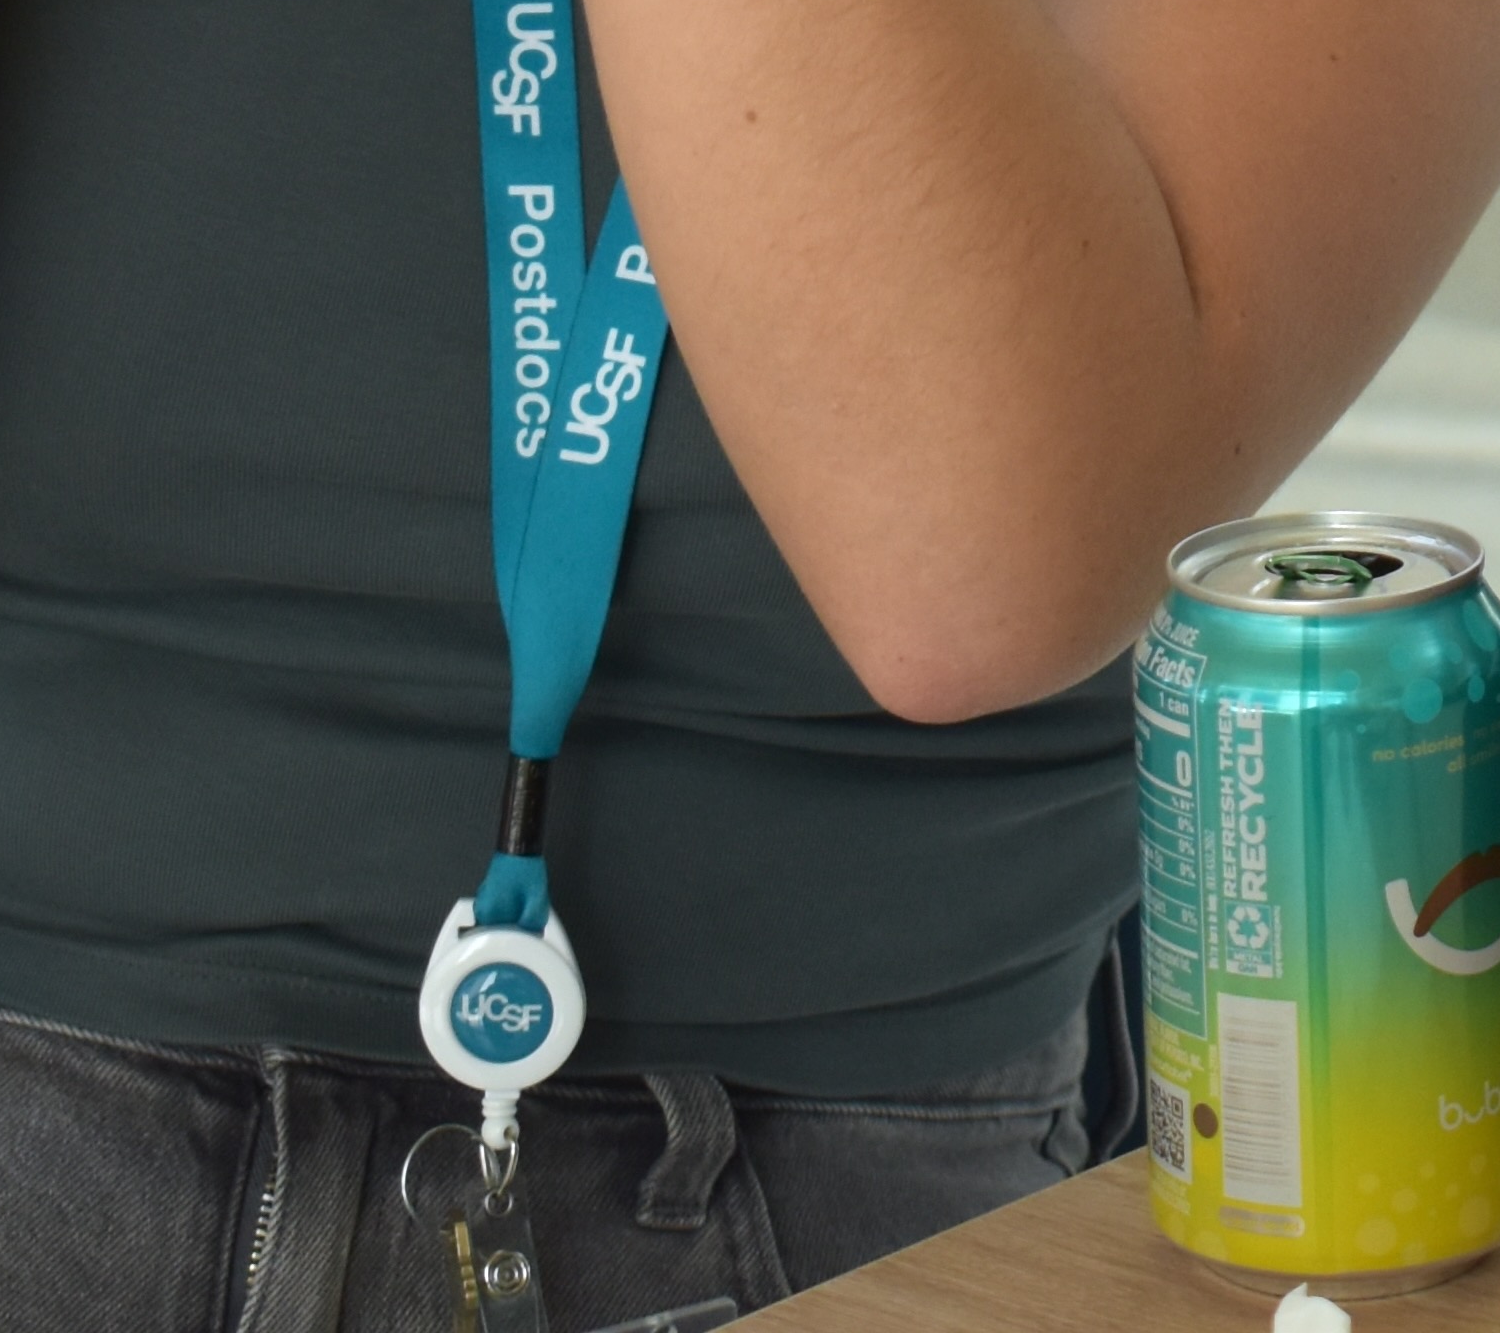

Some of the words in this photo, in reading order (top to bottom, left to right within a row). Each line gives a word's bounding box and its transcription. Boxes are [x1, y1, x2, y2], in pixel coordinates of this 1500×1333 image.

[492, 2, 557, 137] UCSF
[507, 184, 561, 459] Postdocs
[559, 327, 647, 465] UCSF
[1149, 646, 1196, 688] Facts
[1160, 691, 1165, 708] 1
[1167, 698, 1190, 717] can
[1176, 750, 1192, 787] 0
[1218, 697, 1235, 771] THEN
[1372, 749, 1396, 762] no
[1400, 734, 1465, 760] calories
[1221, 775, 1237, 899] REFRESH
[1237, 699, 1268, 902] RECYCLE
[462, 993, 543, 1032] UCSF
